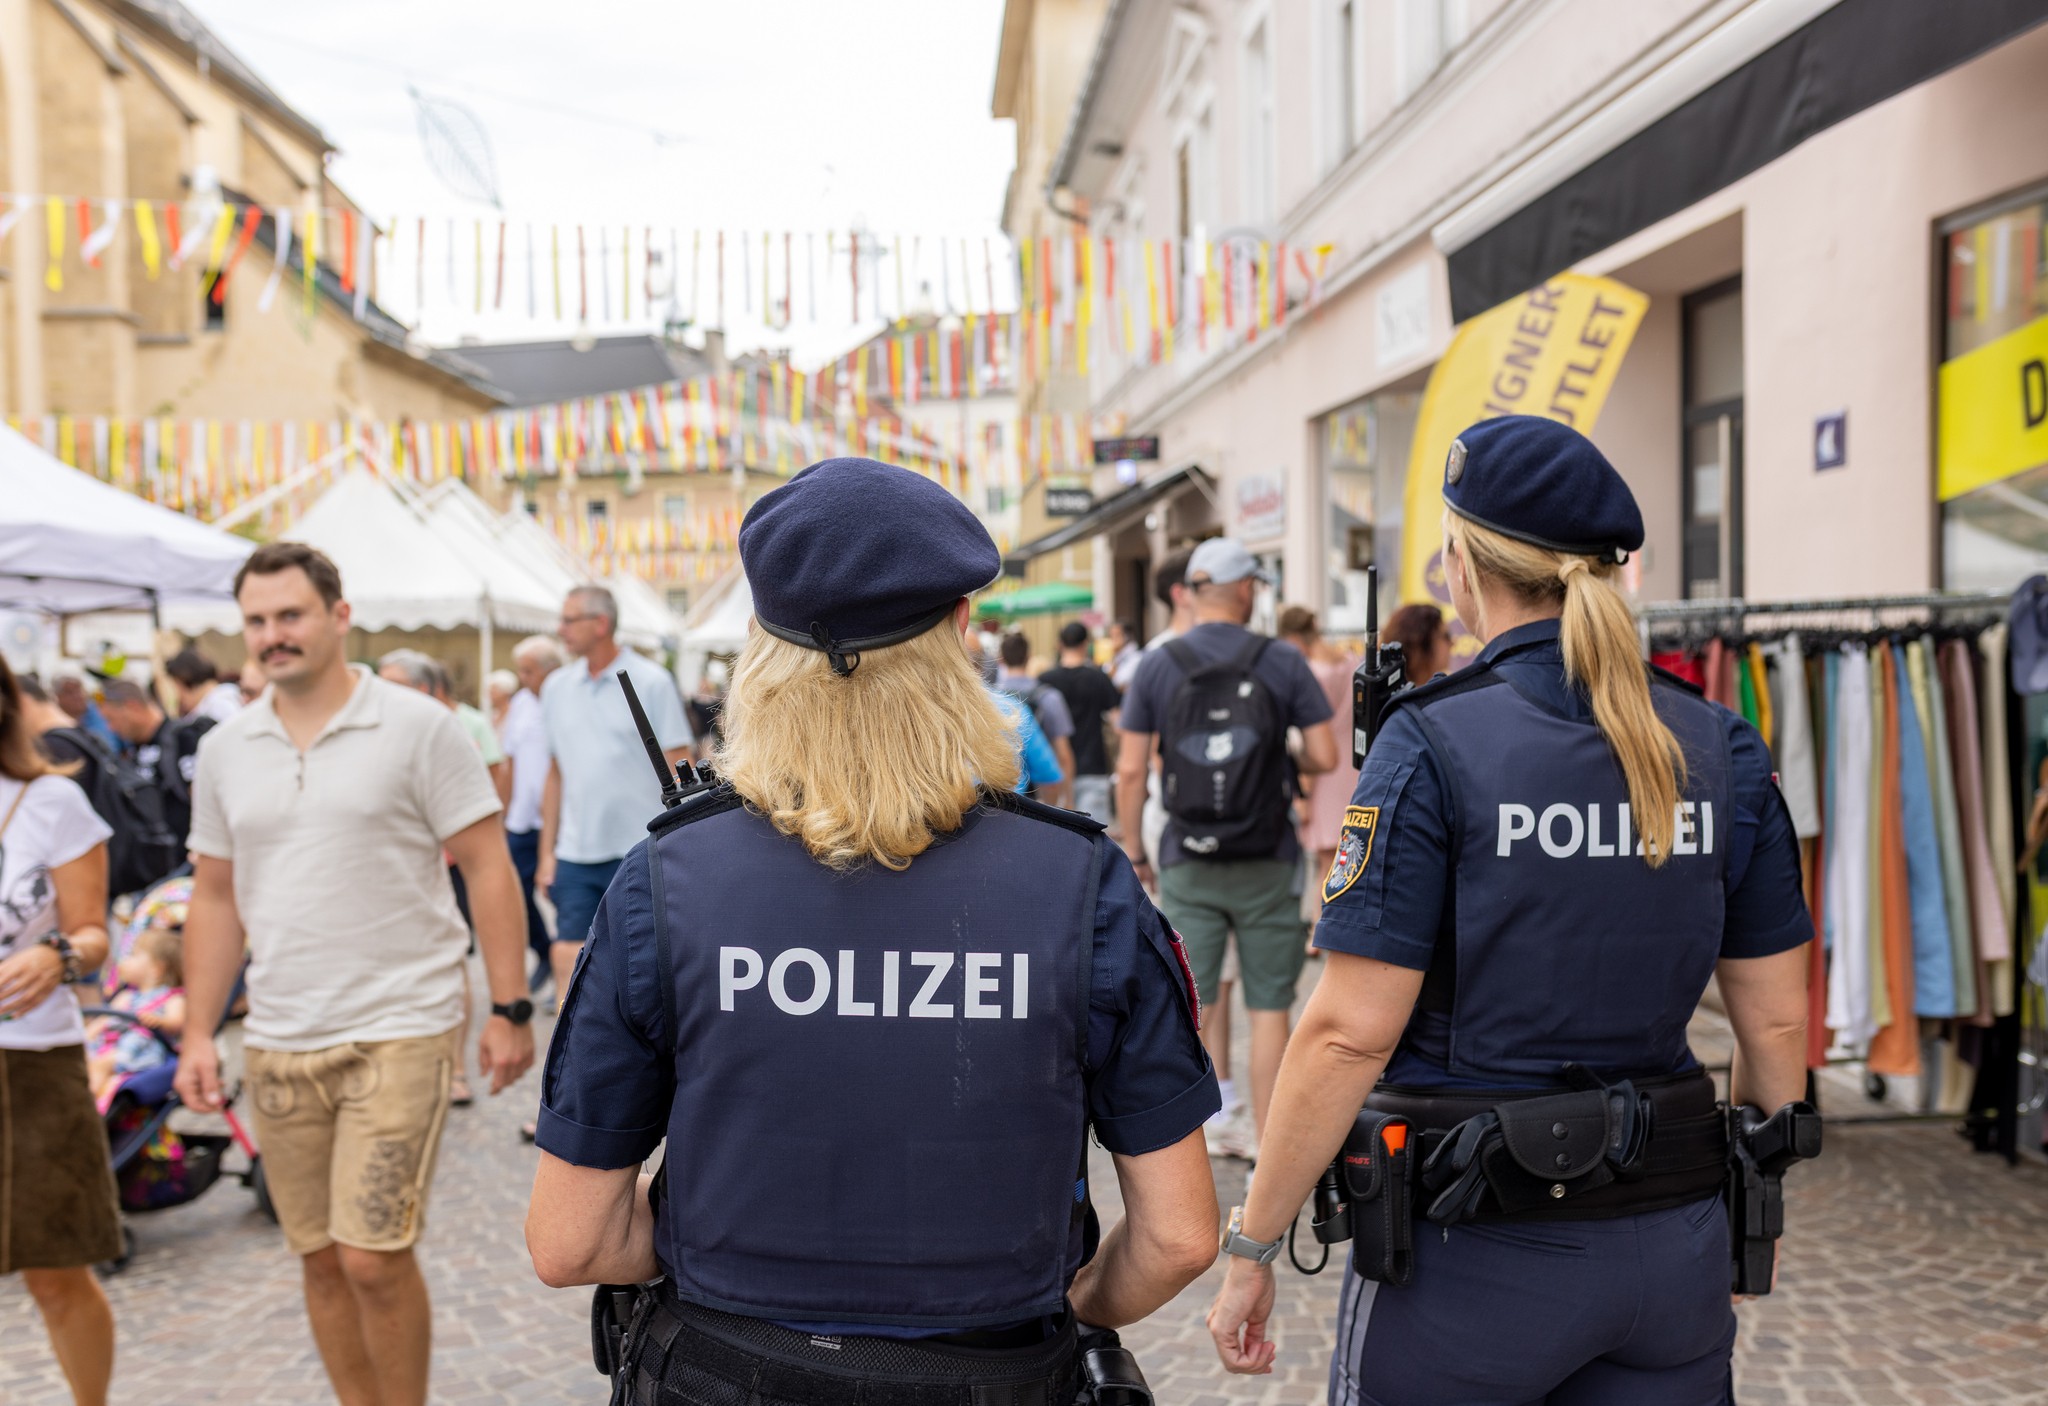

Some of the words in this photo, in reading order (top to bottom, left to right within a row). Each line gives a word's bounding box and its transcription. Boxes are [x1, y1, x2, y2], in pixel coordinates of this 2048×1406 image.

[1478, 283, 1566, 421] IGNER
[1549, 295, 1625, 426] UTLET
[1343, 811, 1374, 829] LIZEI
[719, 945, 1029, 1019] POLIZEI
